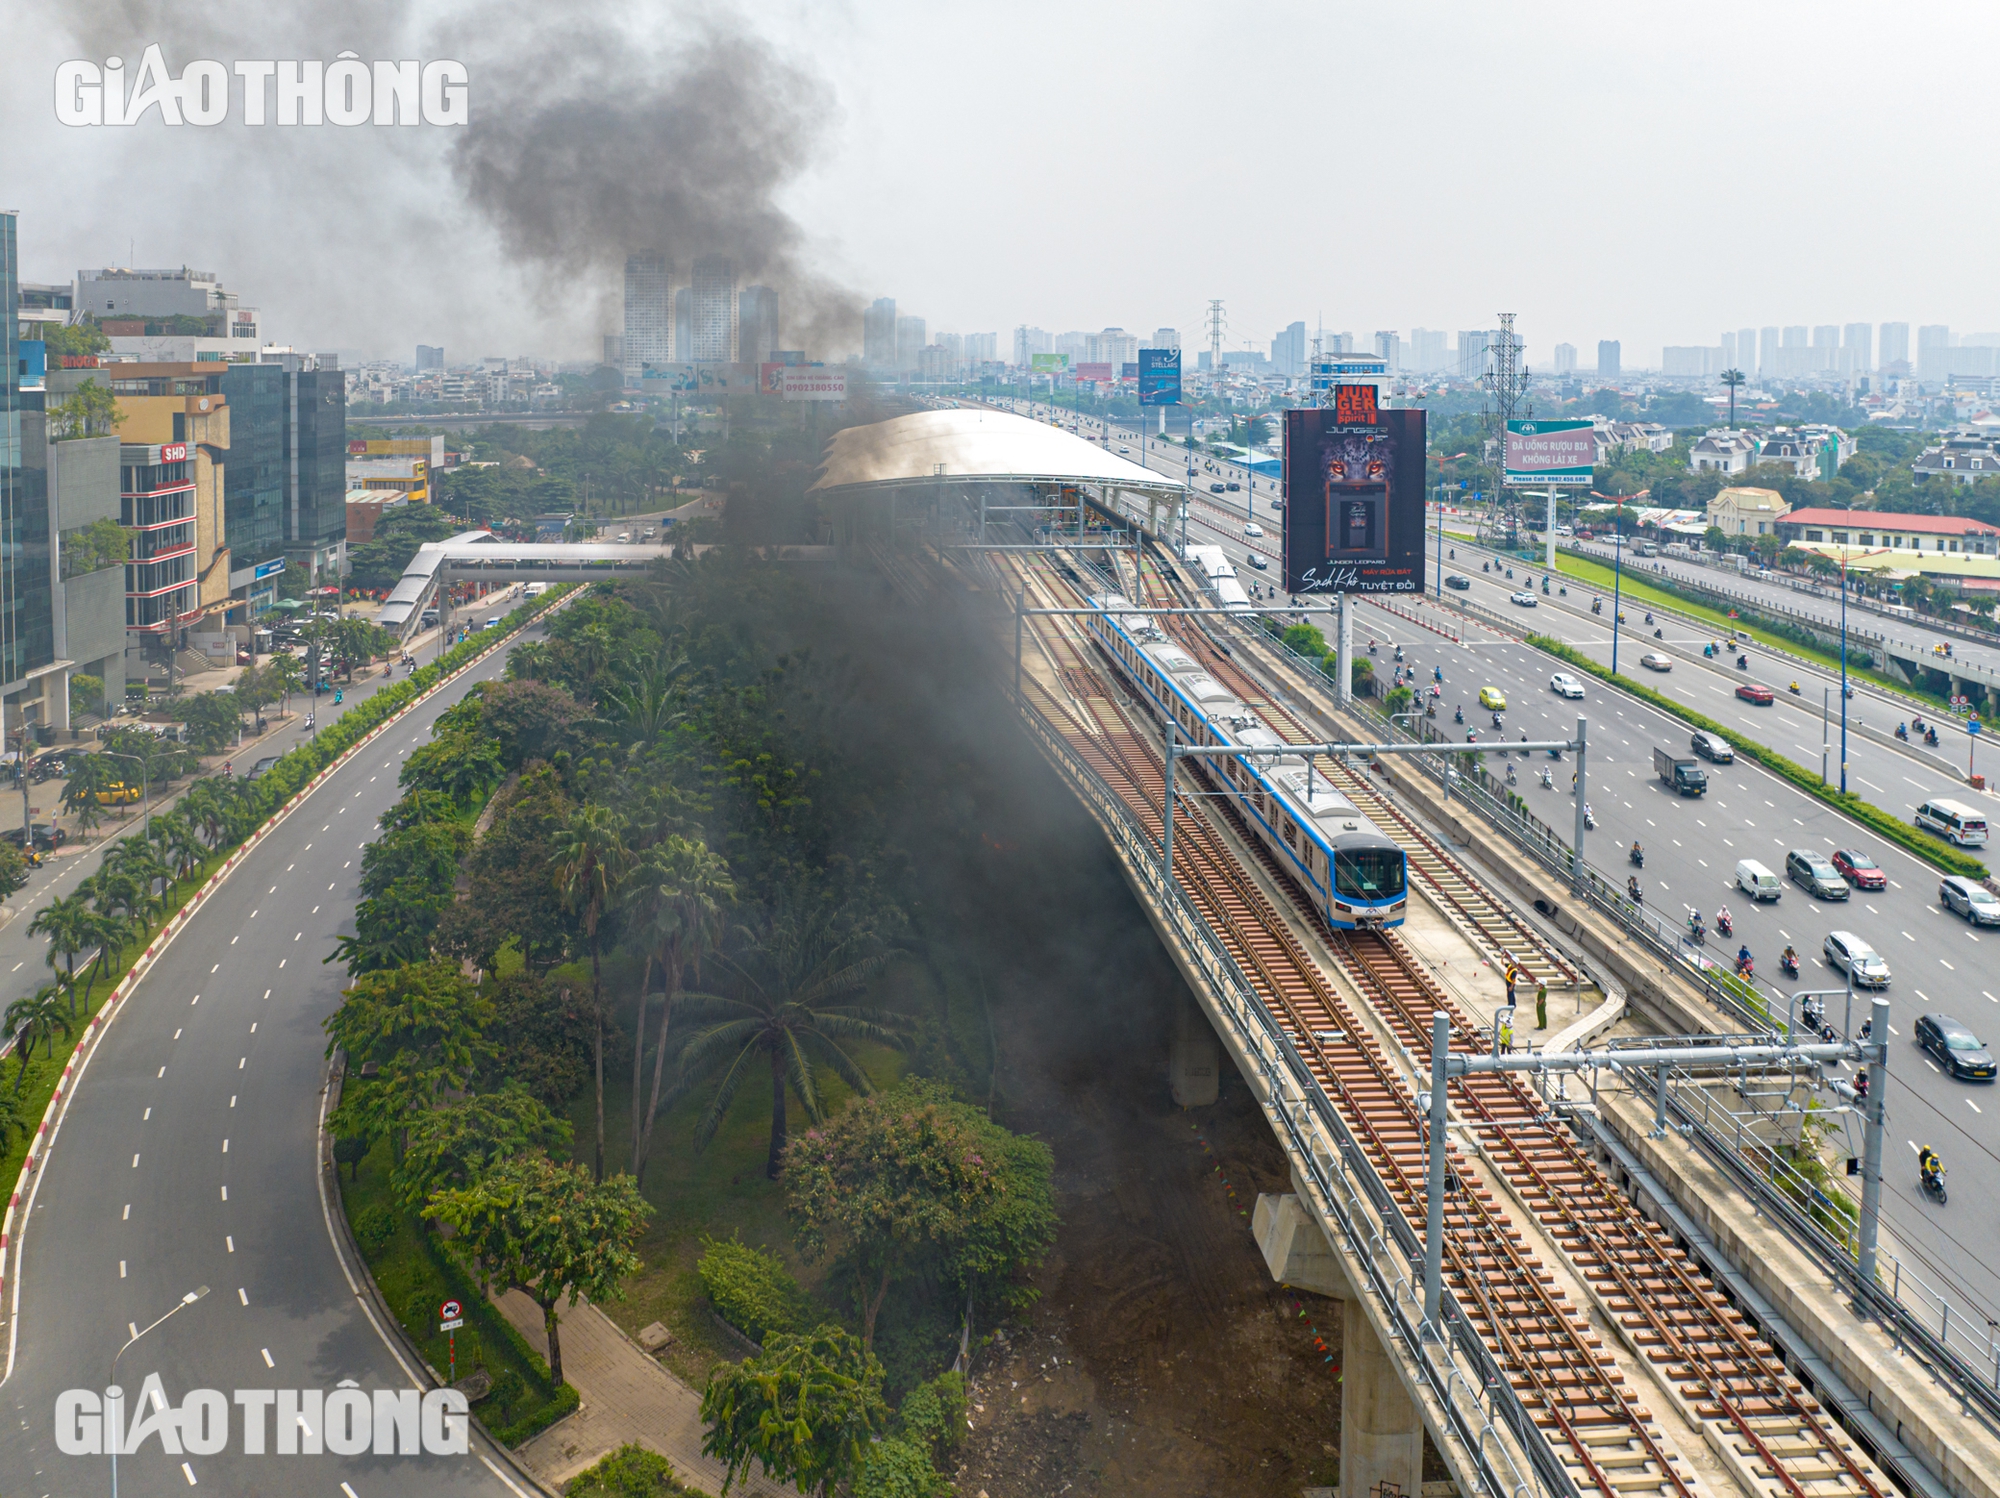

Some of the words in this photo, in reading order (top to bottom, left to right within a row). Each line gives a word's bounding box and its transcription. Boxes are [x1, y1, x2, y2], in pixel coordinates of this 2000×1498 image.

[1164, 344, 1180, 362] 9
[1339, 414, 1366, 424] spirit
[1512, 439, 1524, 450] ĐÃ
[1525, 439, 1548, 451] UỐNG
[1550, 440, 1572, 453] RƯỢU
[1574, 442, 1588, 451] BIA
[165, 446, 185, 461] SHD
[1522, 453, 1550, 464] KHÔNG
[1552, 453, 1566, 464] LÁI
[1567, 456, 1578, 464] XE
[1360, 581, 1395, 591] TUYỆT
[1396, 580, 1415, 590] ĐỐI
